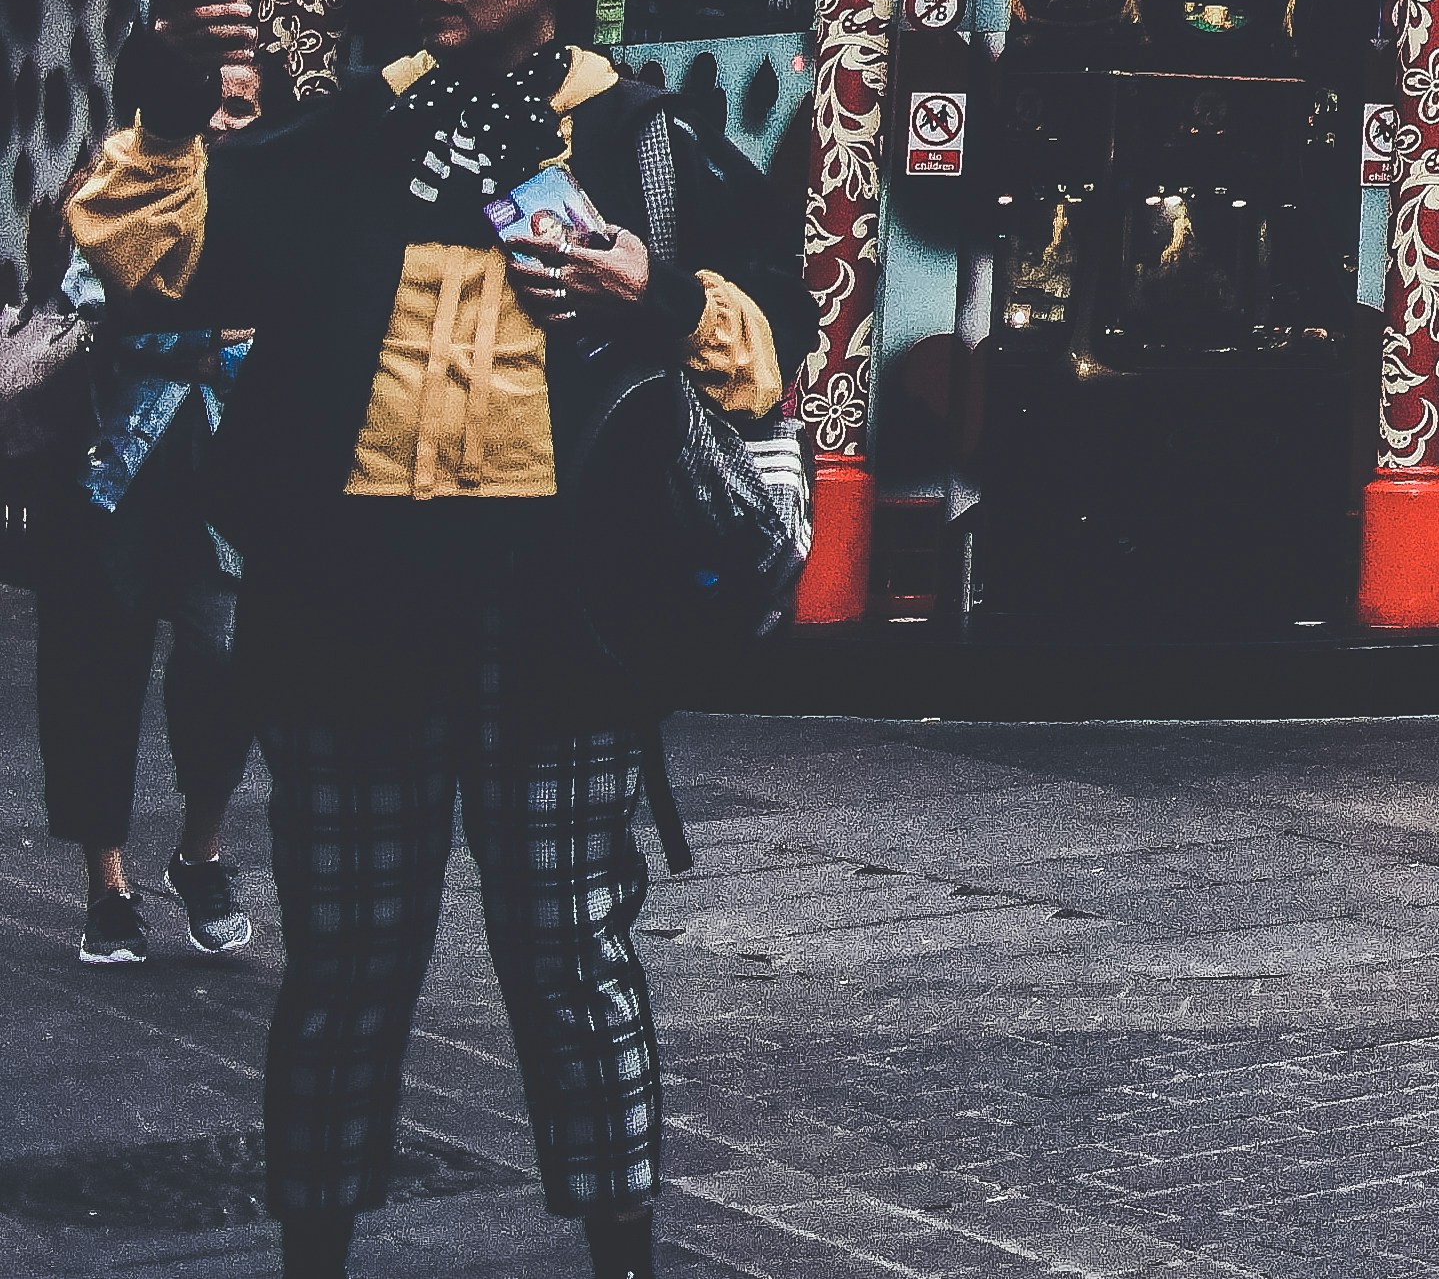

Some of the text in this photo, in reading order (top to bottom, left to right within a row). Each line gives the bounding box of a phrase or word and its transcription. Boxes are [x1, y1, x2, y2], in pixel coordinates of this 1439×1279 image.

[924, 4, 949, 22] 18
[928, 152, 943, 163] No
[914, 160, 956, 173] children
